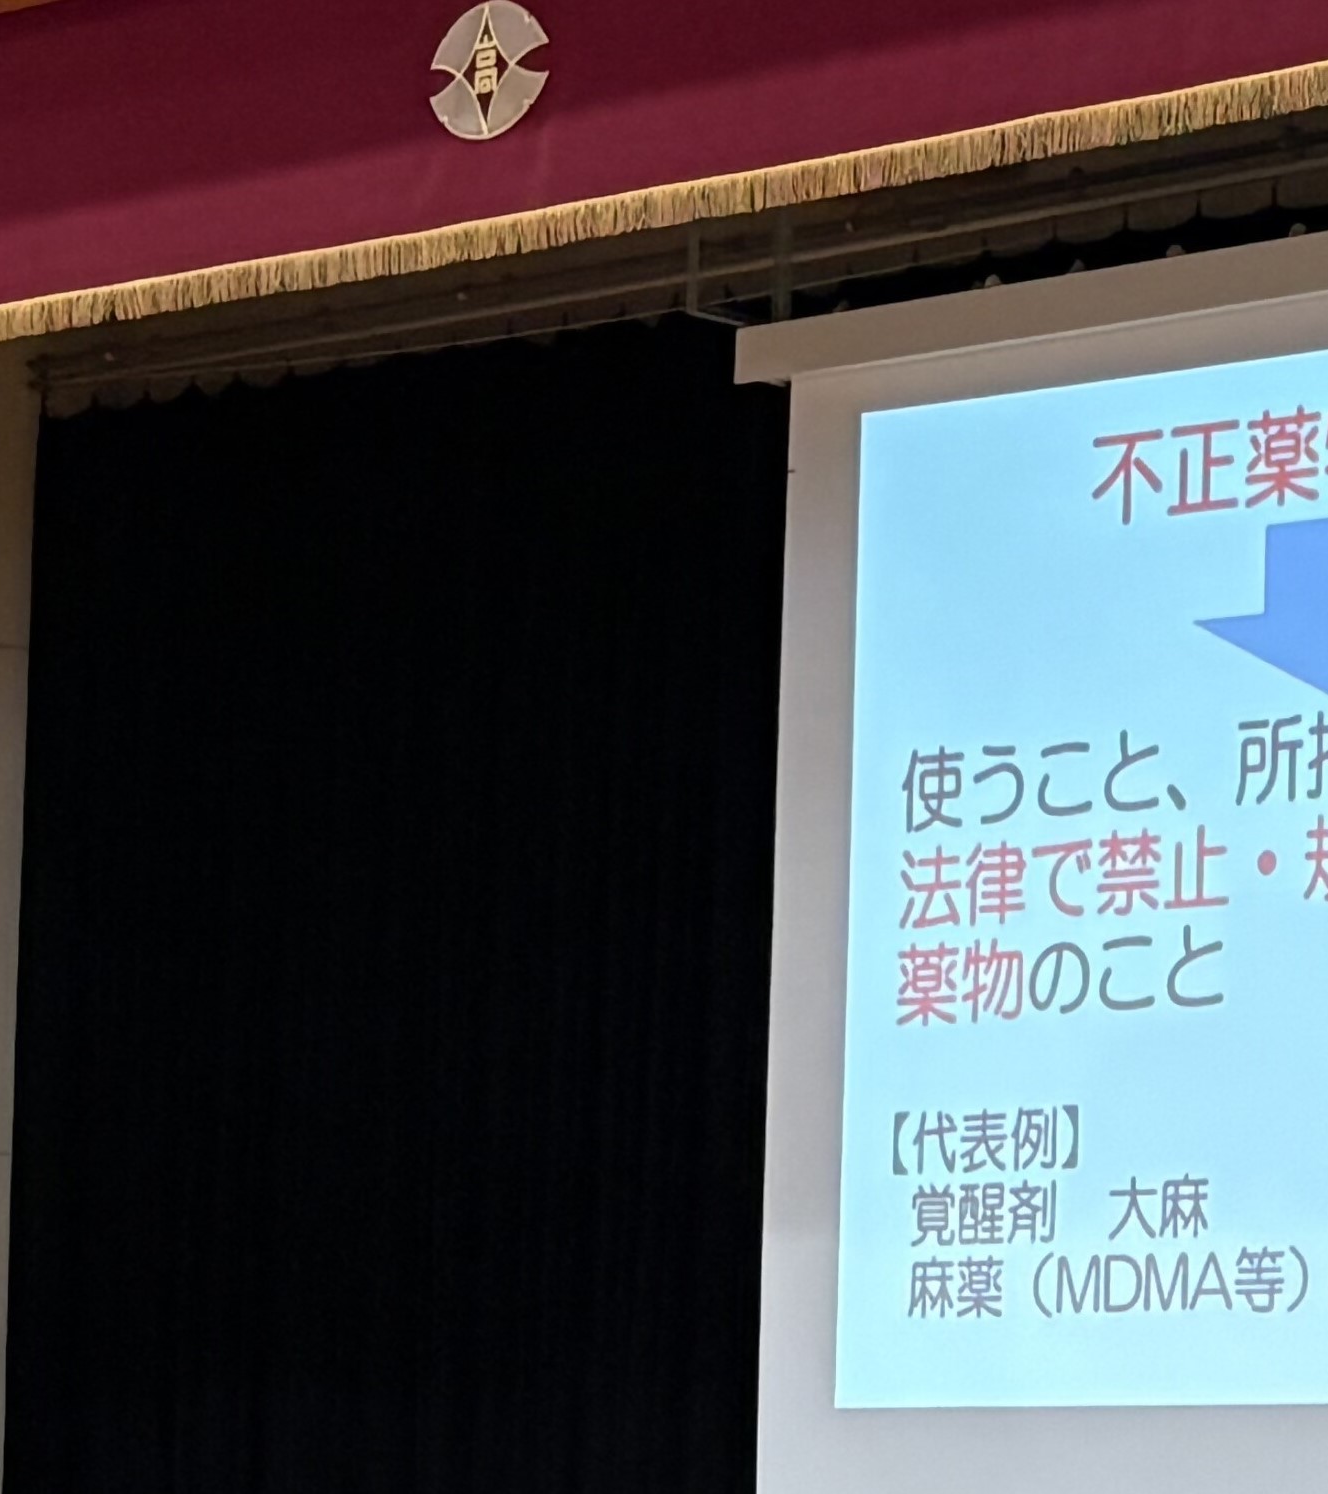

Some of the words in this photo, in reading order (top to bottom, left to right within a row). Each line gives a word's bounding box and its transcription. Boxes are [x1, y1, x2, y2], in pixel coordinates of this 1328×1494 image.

[897, 926, 1224, 1026] 薬物のこと
[892, 1104, 1079, 1176] 【代表例】
[910, 1179, 1057, 1247] 覚醒剤
[1108, 1173, 1209, 1241] 大麻
